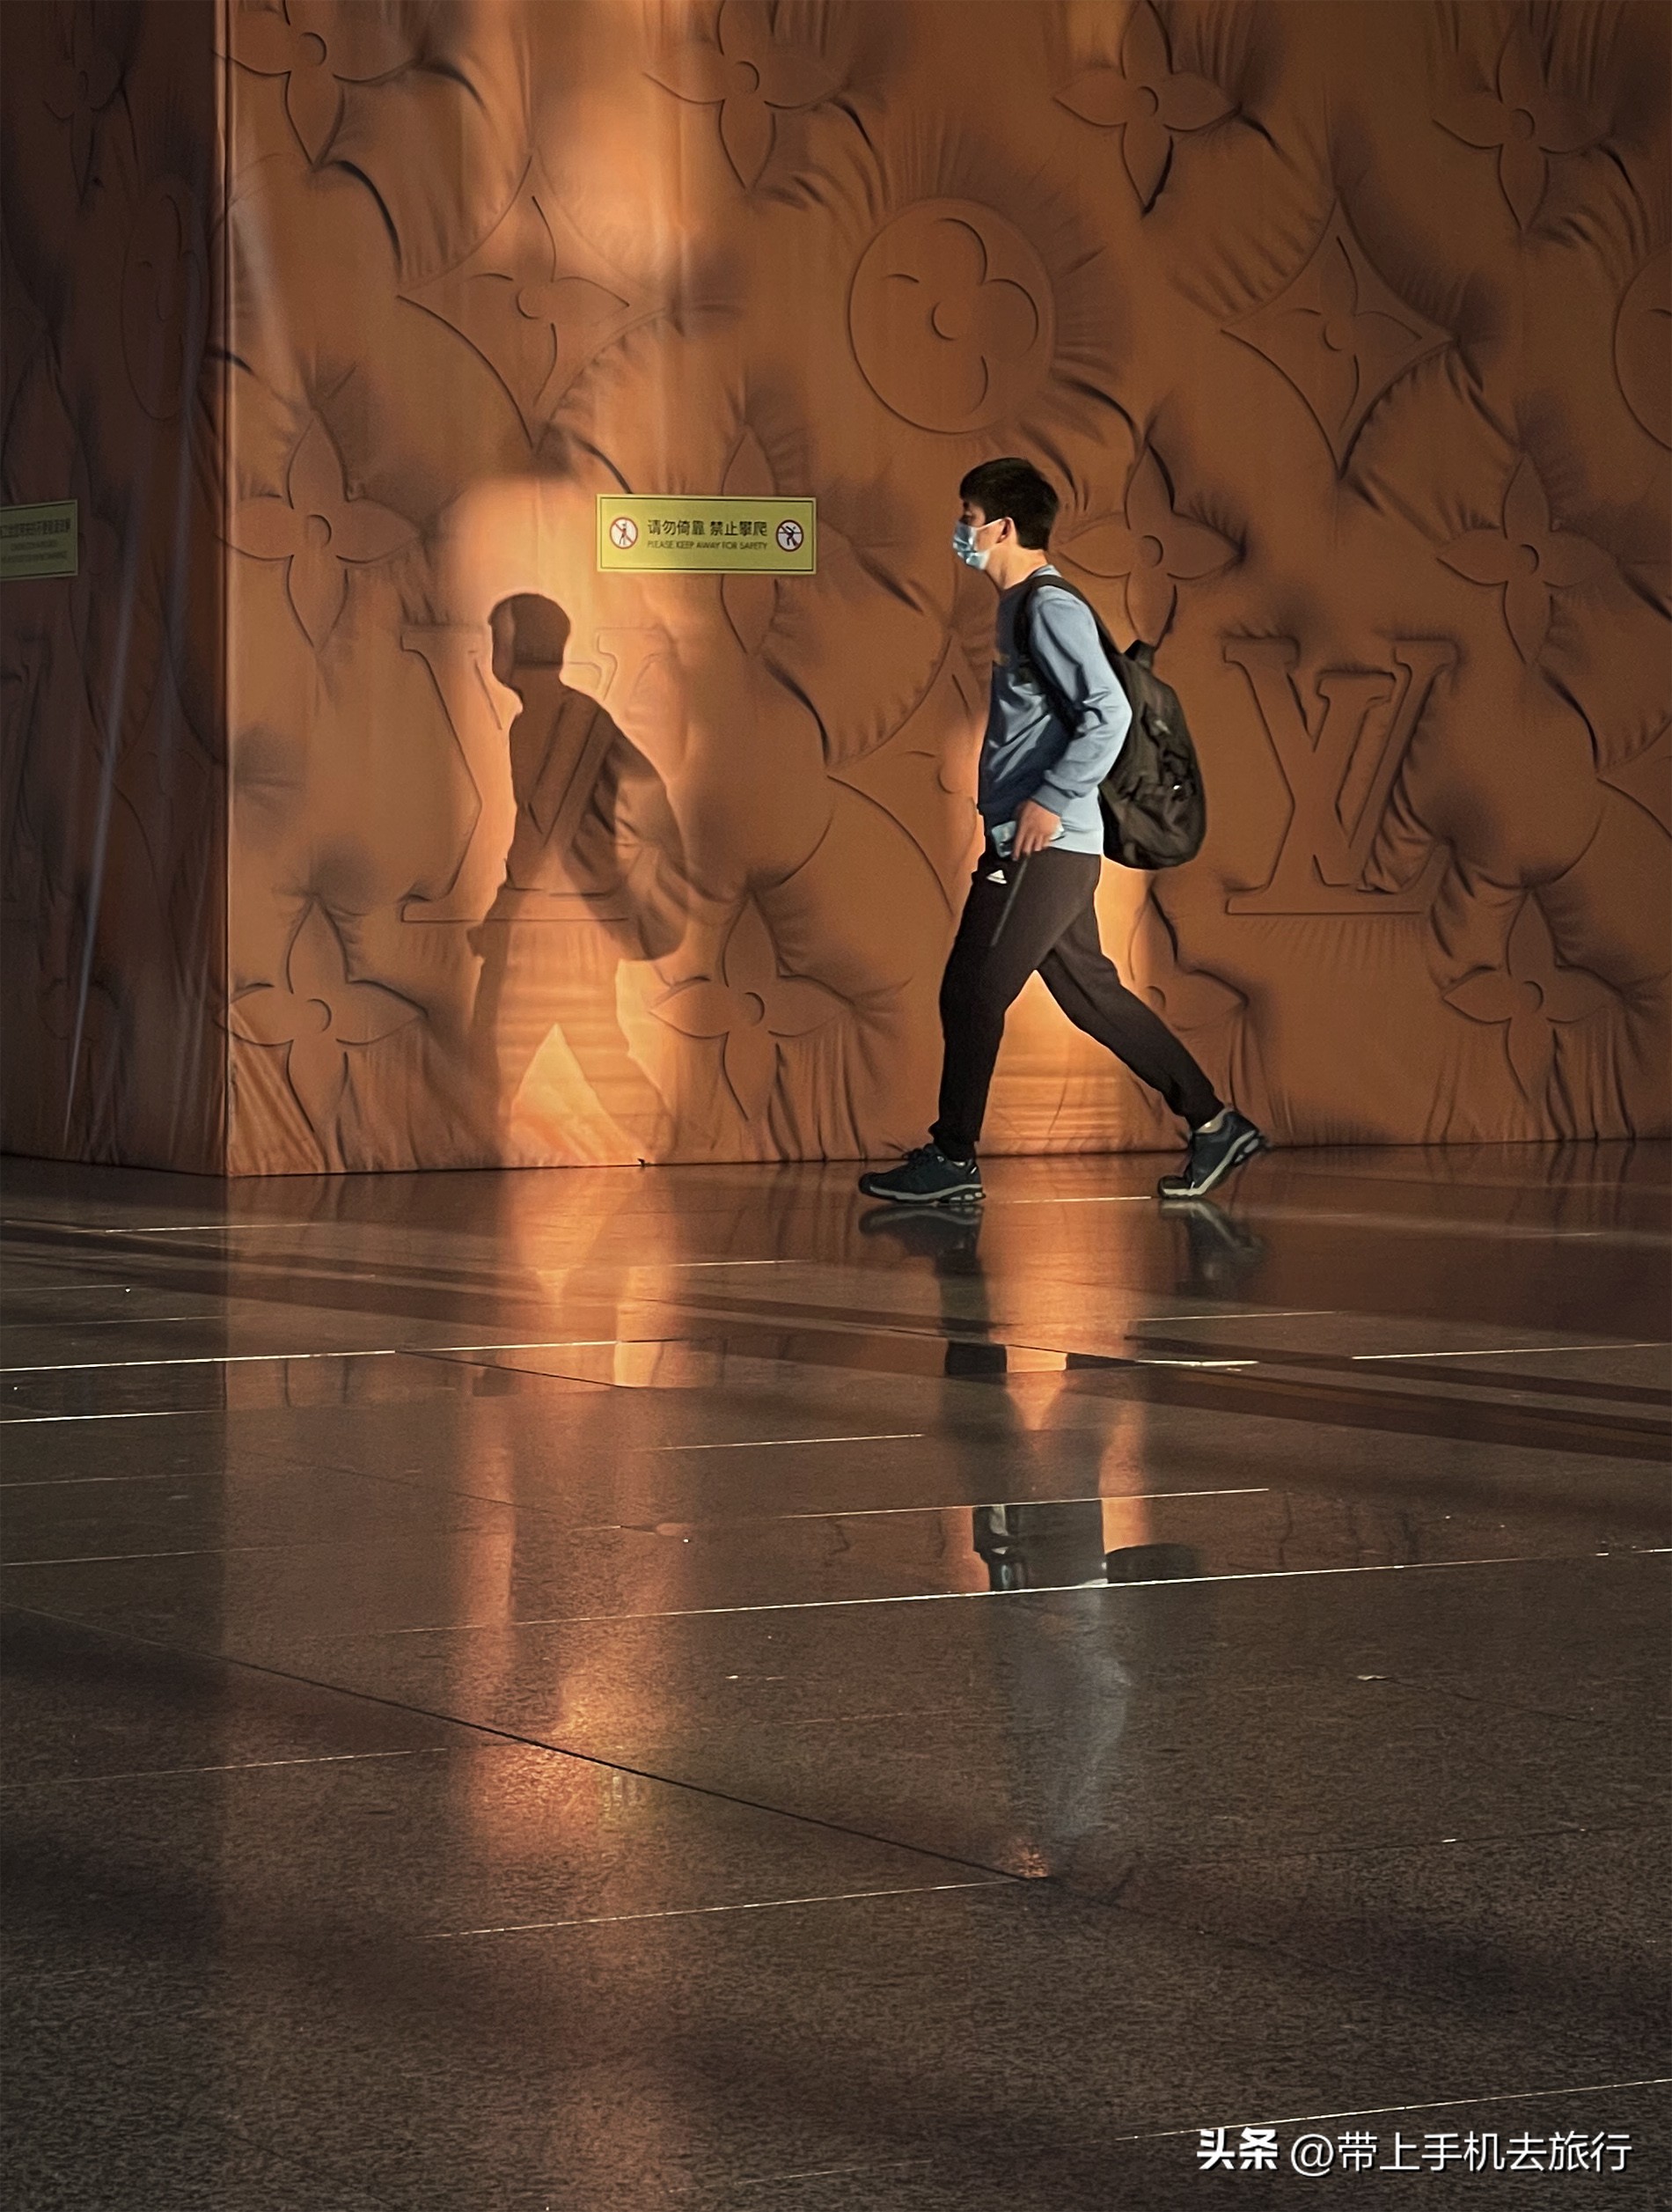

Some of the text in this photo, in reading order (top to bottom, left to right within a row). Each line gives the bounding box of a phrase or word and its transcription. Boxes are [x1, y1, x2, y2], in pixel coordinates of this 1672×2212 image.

[648, 519, 767, 536] 请勿倚靠 禁止攀爬
[648, 540, 674, 549] PLEASE
[676, 540, 694, 549] KEEP
[739, 541, 767, 550] SAFETY
